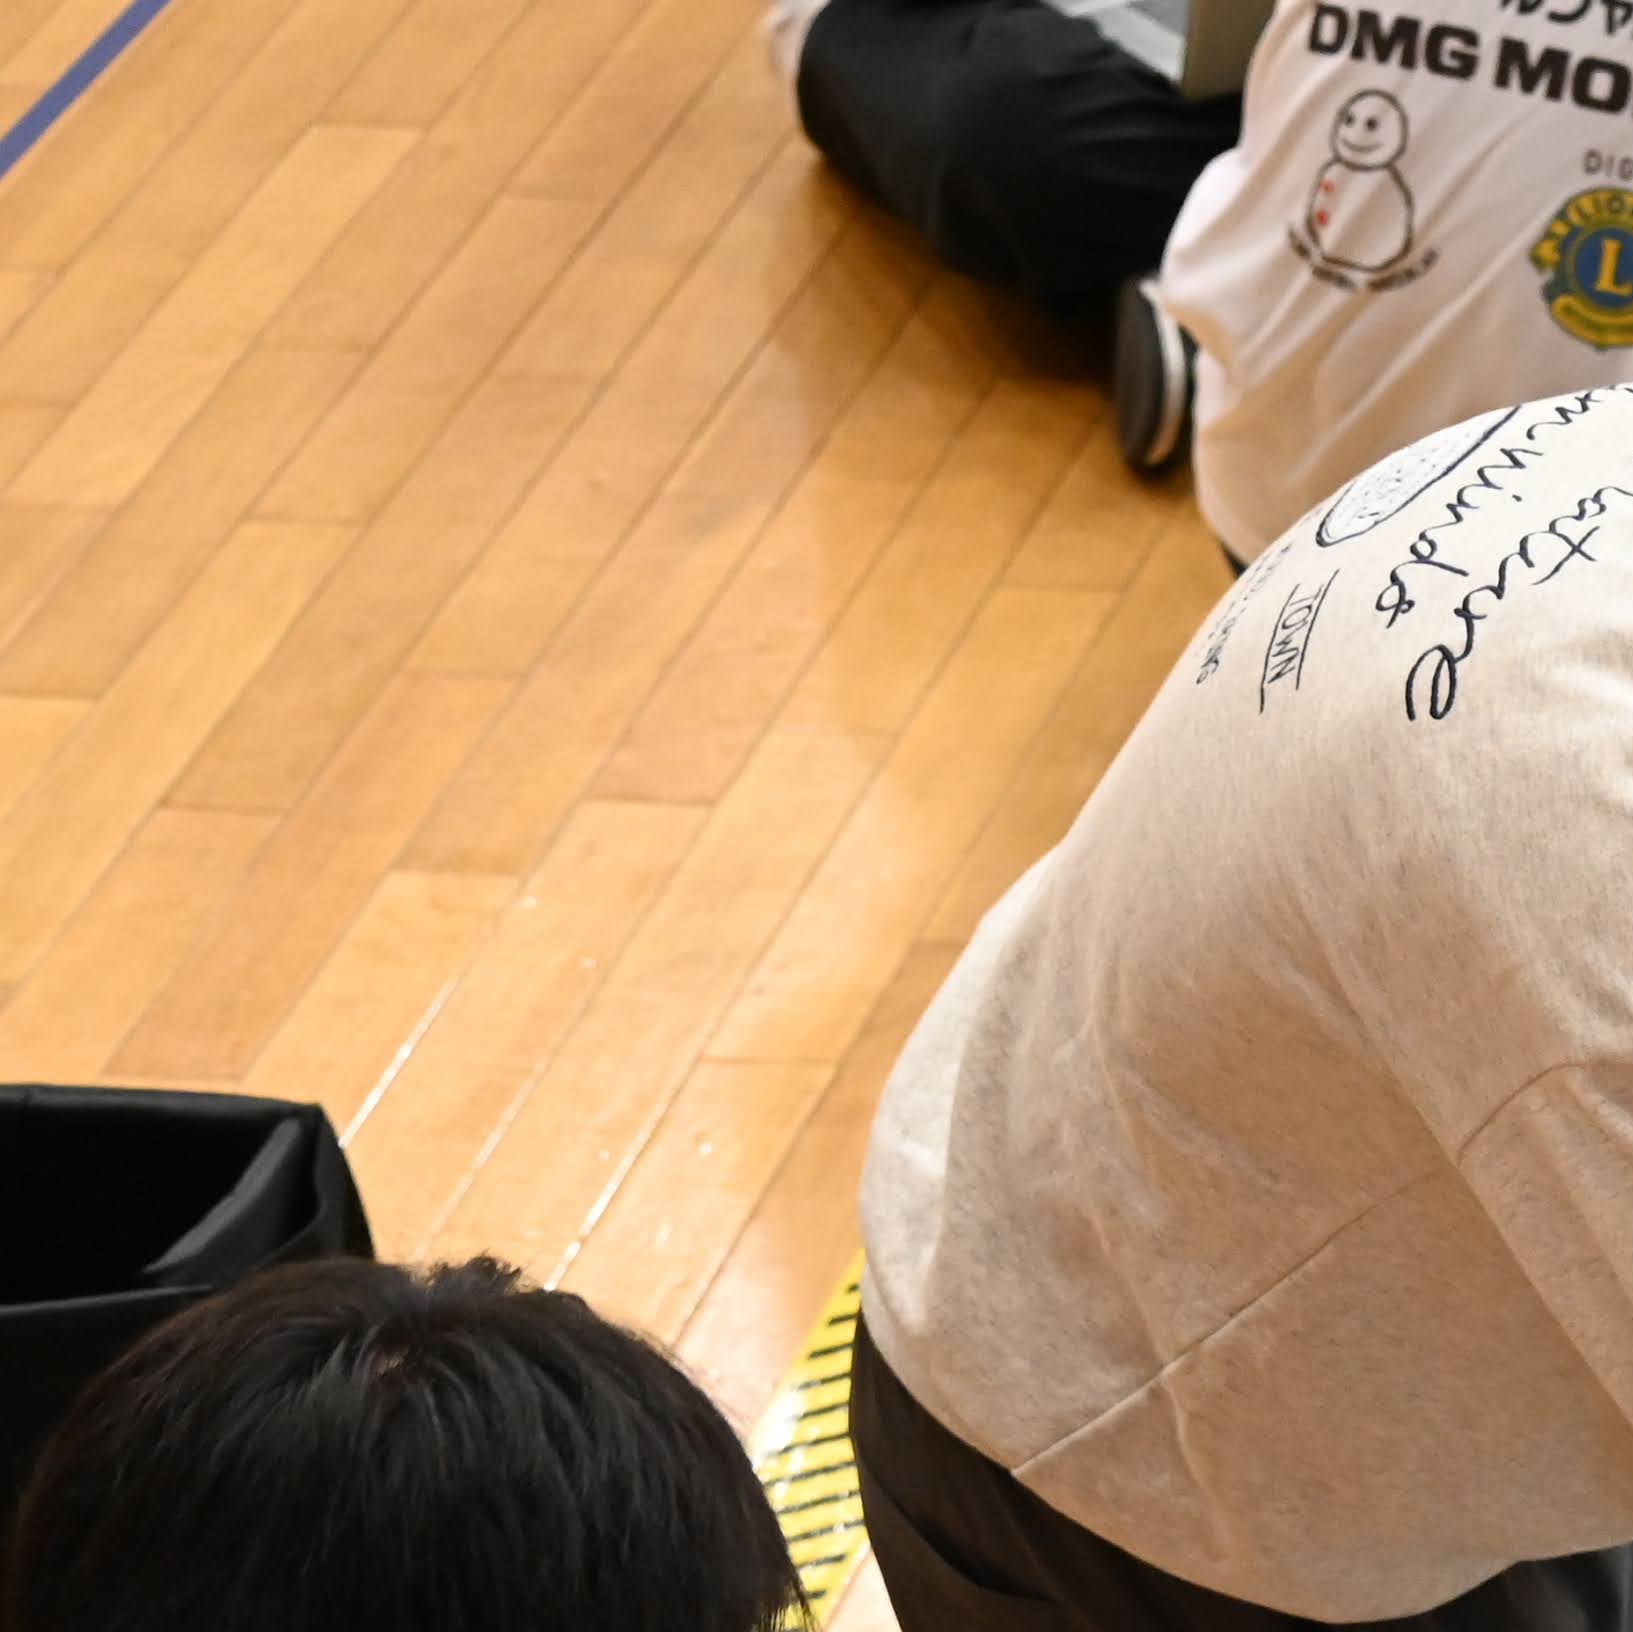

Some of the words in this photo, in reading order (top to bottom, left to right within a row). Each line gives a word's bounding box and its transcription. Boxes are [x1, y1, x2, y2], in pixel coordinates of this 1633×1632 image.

[1308, 3, 1480, 81] DMG
[1594, 238, 1633, 297] L
[1267, 585, 1325, 684] TOWN
